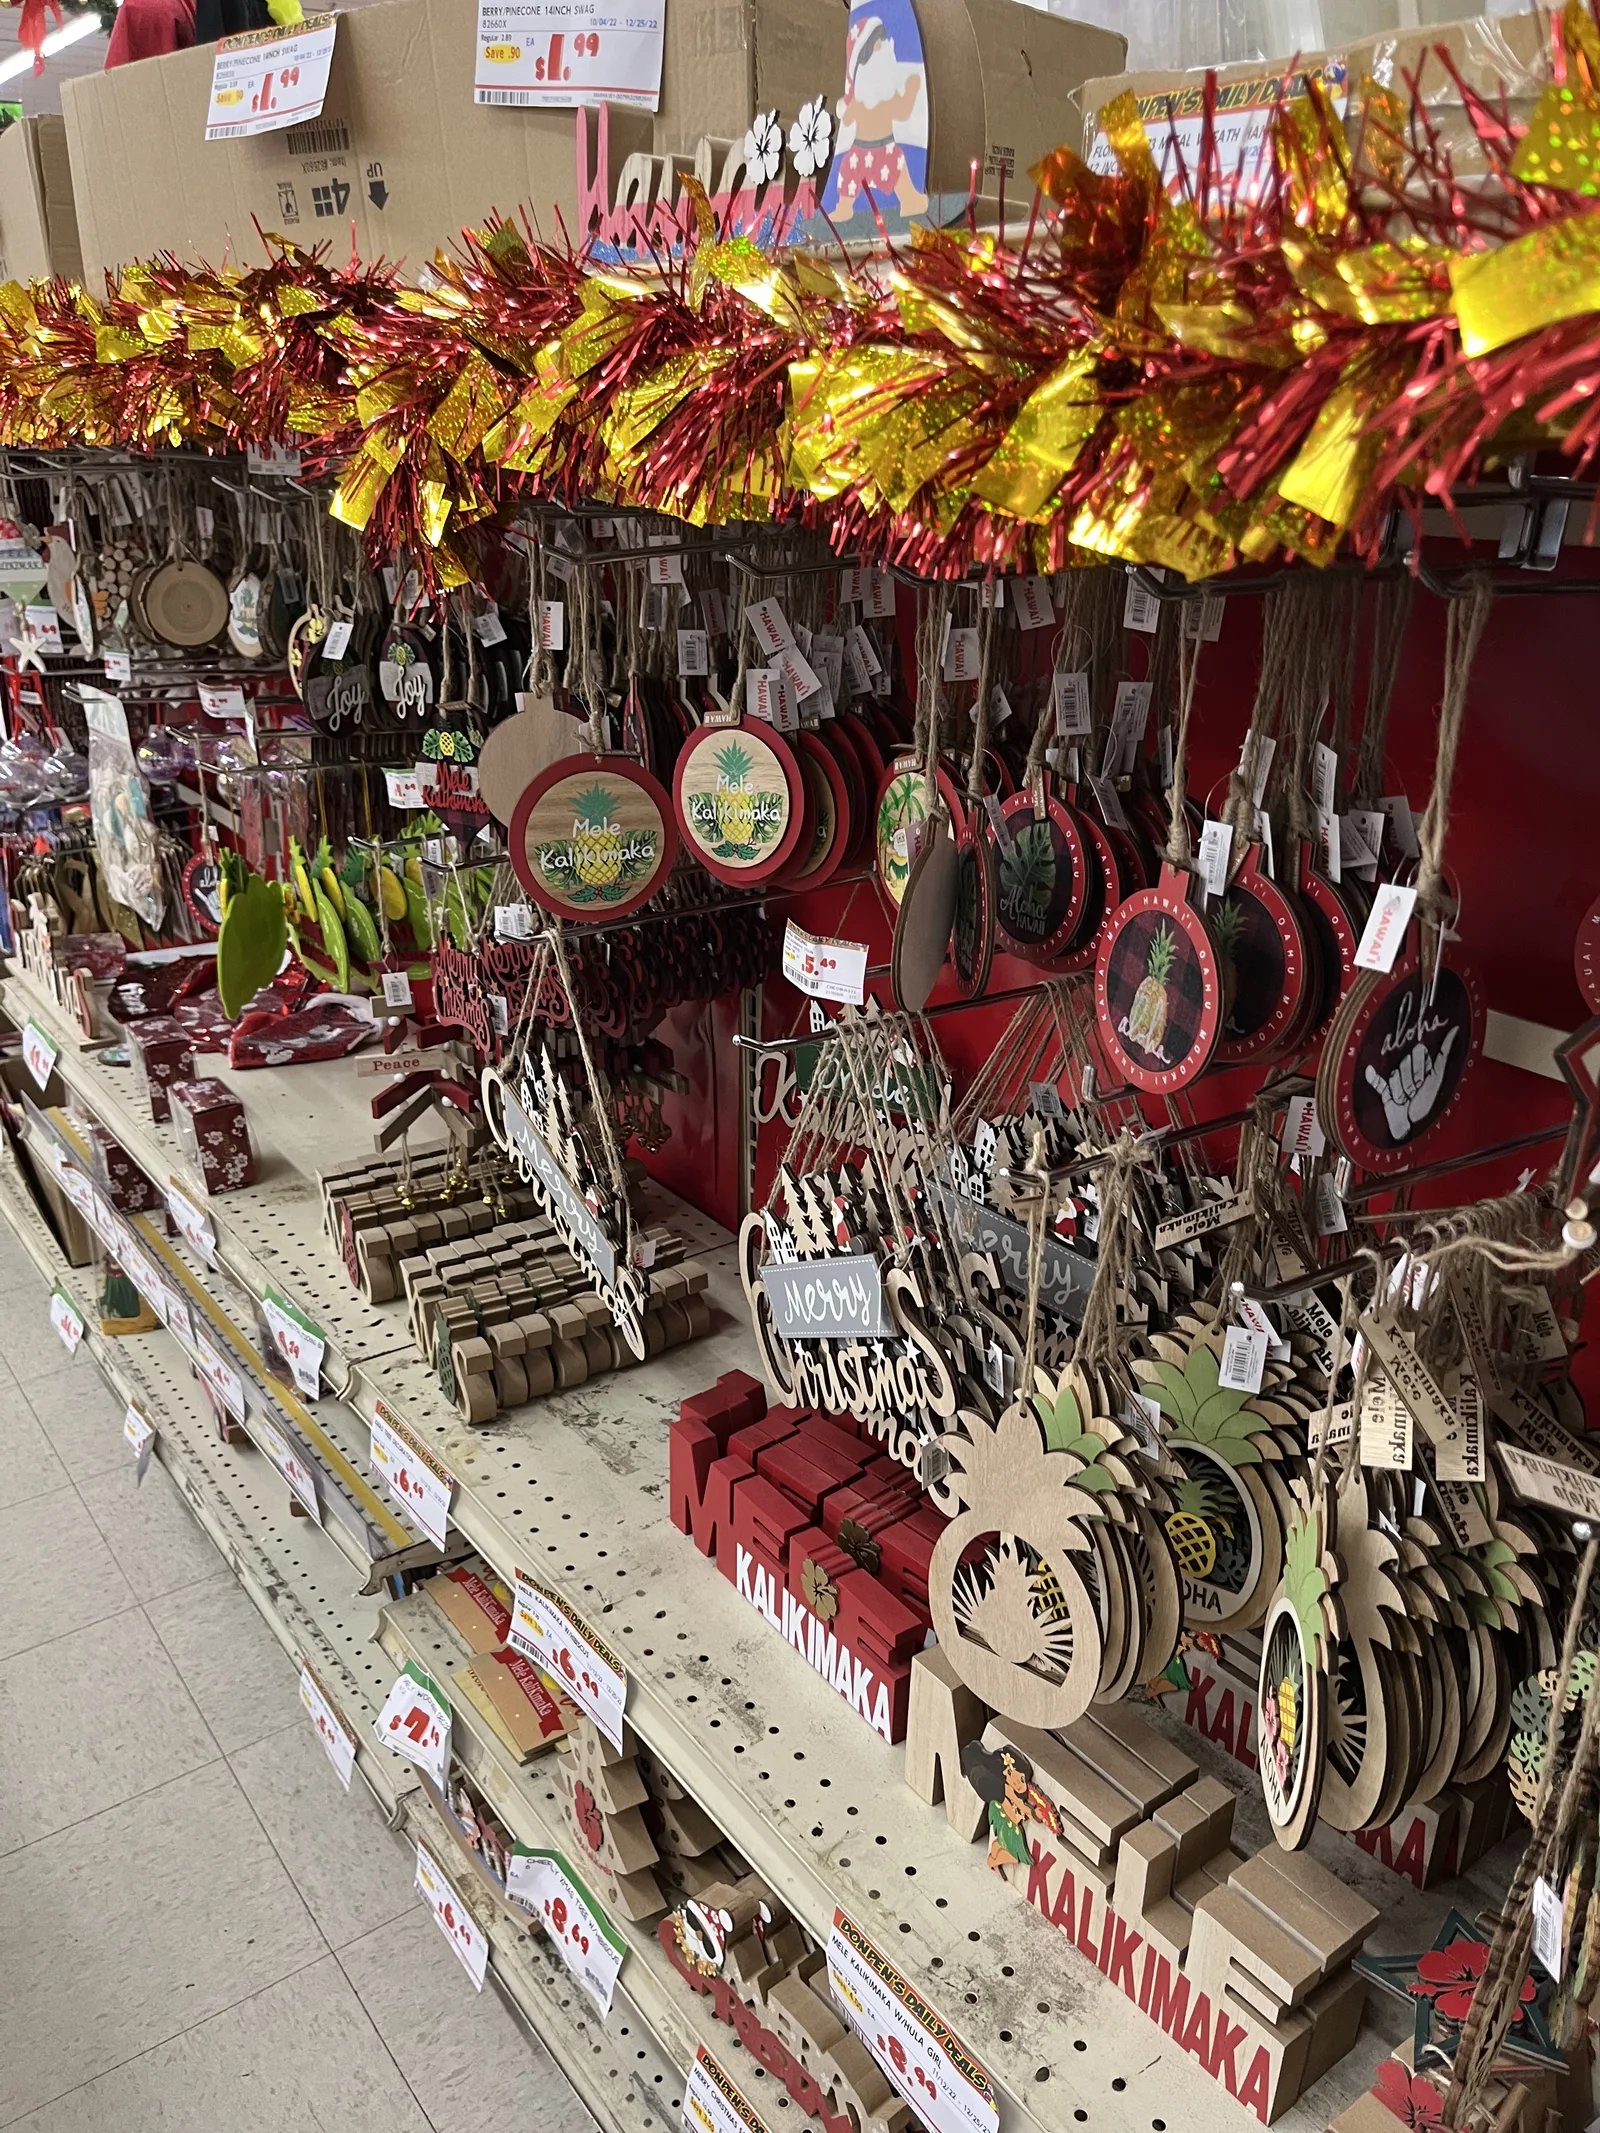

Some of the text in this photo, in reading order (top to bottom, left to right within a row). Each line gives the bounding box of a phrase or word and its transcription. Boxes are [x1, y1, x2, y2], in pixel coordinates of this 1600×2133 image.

[482, 4, 595, 17] BERRY/PINECONE 14INCH SWAG
[625, 18, 658, 29] 12/25/22
[485, 46, 521, 59] Save .90
[525, 37, 535, 47] EA
[535, 32, 600, 81] $1.99
[247, 80, 255, 89] EA
[251, 66, 300, 113] $1.99
[366, 161, 384, 178] UP
[1026, 585, 1042, 627] HAWAI'I
[541, 610, 555, 650] HAWAI'I
[760, 610, 787, 649] HAWAI'I
[782, 659, 812, 698] HAWAI'I
[954, 639, 968, 681] HAWAI'I
[327, 674, 366, 732] Joy
[394, 664, 427, 720] Joy
[757, 679, 772, 721] HAWAI'I
[777, 690, 793, 730] HAWAI'I
[436, 760, 471, 793] Mele
[715, 774, 754, 796] Mele
[572, 816, 622, 838] Mele
[690, 800, 781, 823] Kalikimaka
[539, 843, 656, 871] Kalikimaka
[1065, 829, 1080, 878] OAHU
[1095, 841, 1113, 890] OAHU
[1000, 884, 1048, 921] Aloha
[1106, 903, 1133, 942] MAUI
[1143, 895, 1193, 930] HAWAI'I
[801, 953, 837, 976] $5.49
[1276, 916, 1296, 975] OAHU
[1331, 915, 1350, 973] OAHU
[1097, 956, 1108, 1022] KAUAI
[1199, 949, 1213, 1010] OAHU
[1380, 989, 1449, 1057] aloha
[371, 1055, 421, 1073] Peace
[1108, 1036, 1144, 1081] LANAI
[1153, 1028, 1208, 1086] MOLOKAI
[1294, 1106, 1315, 1152] HAWAI'I
[516, 1128, 605, 1255] Merry
[1158, 1196, 1241, 1235] Kalikimaka
[1185, 1213, 1221, 1237] Mele
[739, 1212, 957, 1418] Christmas
[783, 1272, 872, 1327] Merry
[1305, 1301, 1334, 1340] Mele
[463, 1576, 480, 1596] Mele
[517, 1583, 533, 1600] MELE
[534, 1594, 564, 1628] KALIKIMAKA
[521, 1572, 621, 1672] DONPEN'S DAILY DEALS
[735, 1542, 893, 1746] KALIKIMAKA
[508, 1658, 527, 1681] Mele
[551, 1647, 599, 1700] $6.99
[388, 1704, 441, 1749] $7.19
[543, 1896, 590, 1957] $8.69
[831, 1935, 943, 2071] MELE KALIKIMAKA W/HULA GIRL
[1026, 1837, 1275, 2127] KALIKIMAKA
[839, 1917, 989, 2091] DONPEN'S DAILY DEALS
[866, 2007, 877, 2023] EA
[702, 2053, 751, 2120] DONPEN'S
[876, 2032, 938, 2102] $8.99
[931, 2065, 958, 2101] 11/12/22
[693, 2066, 739, 2130] MERRY CHRISTMAS
